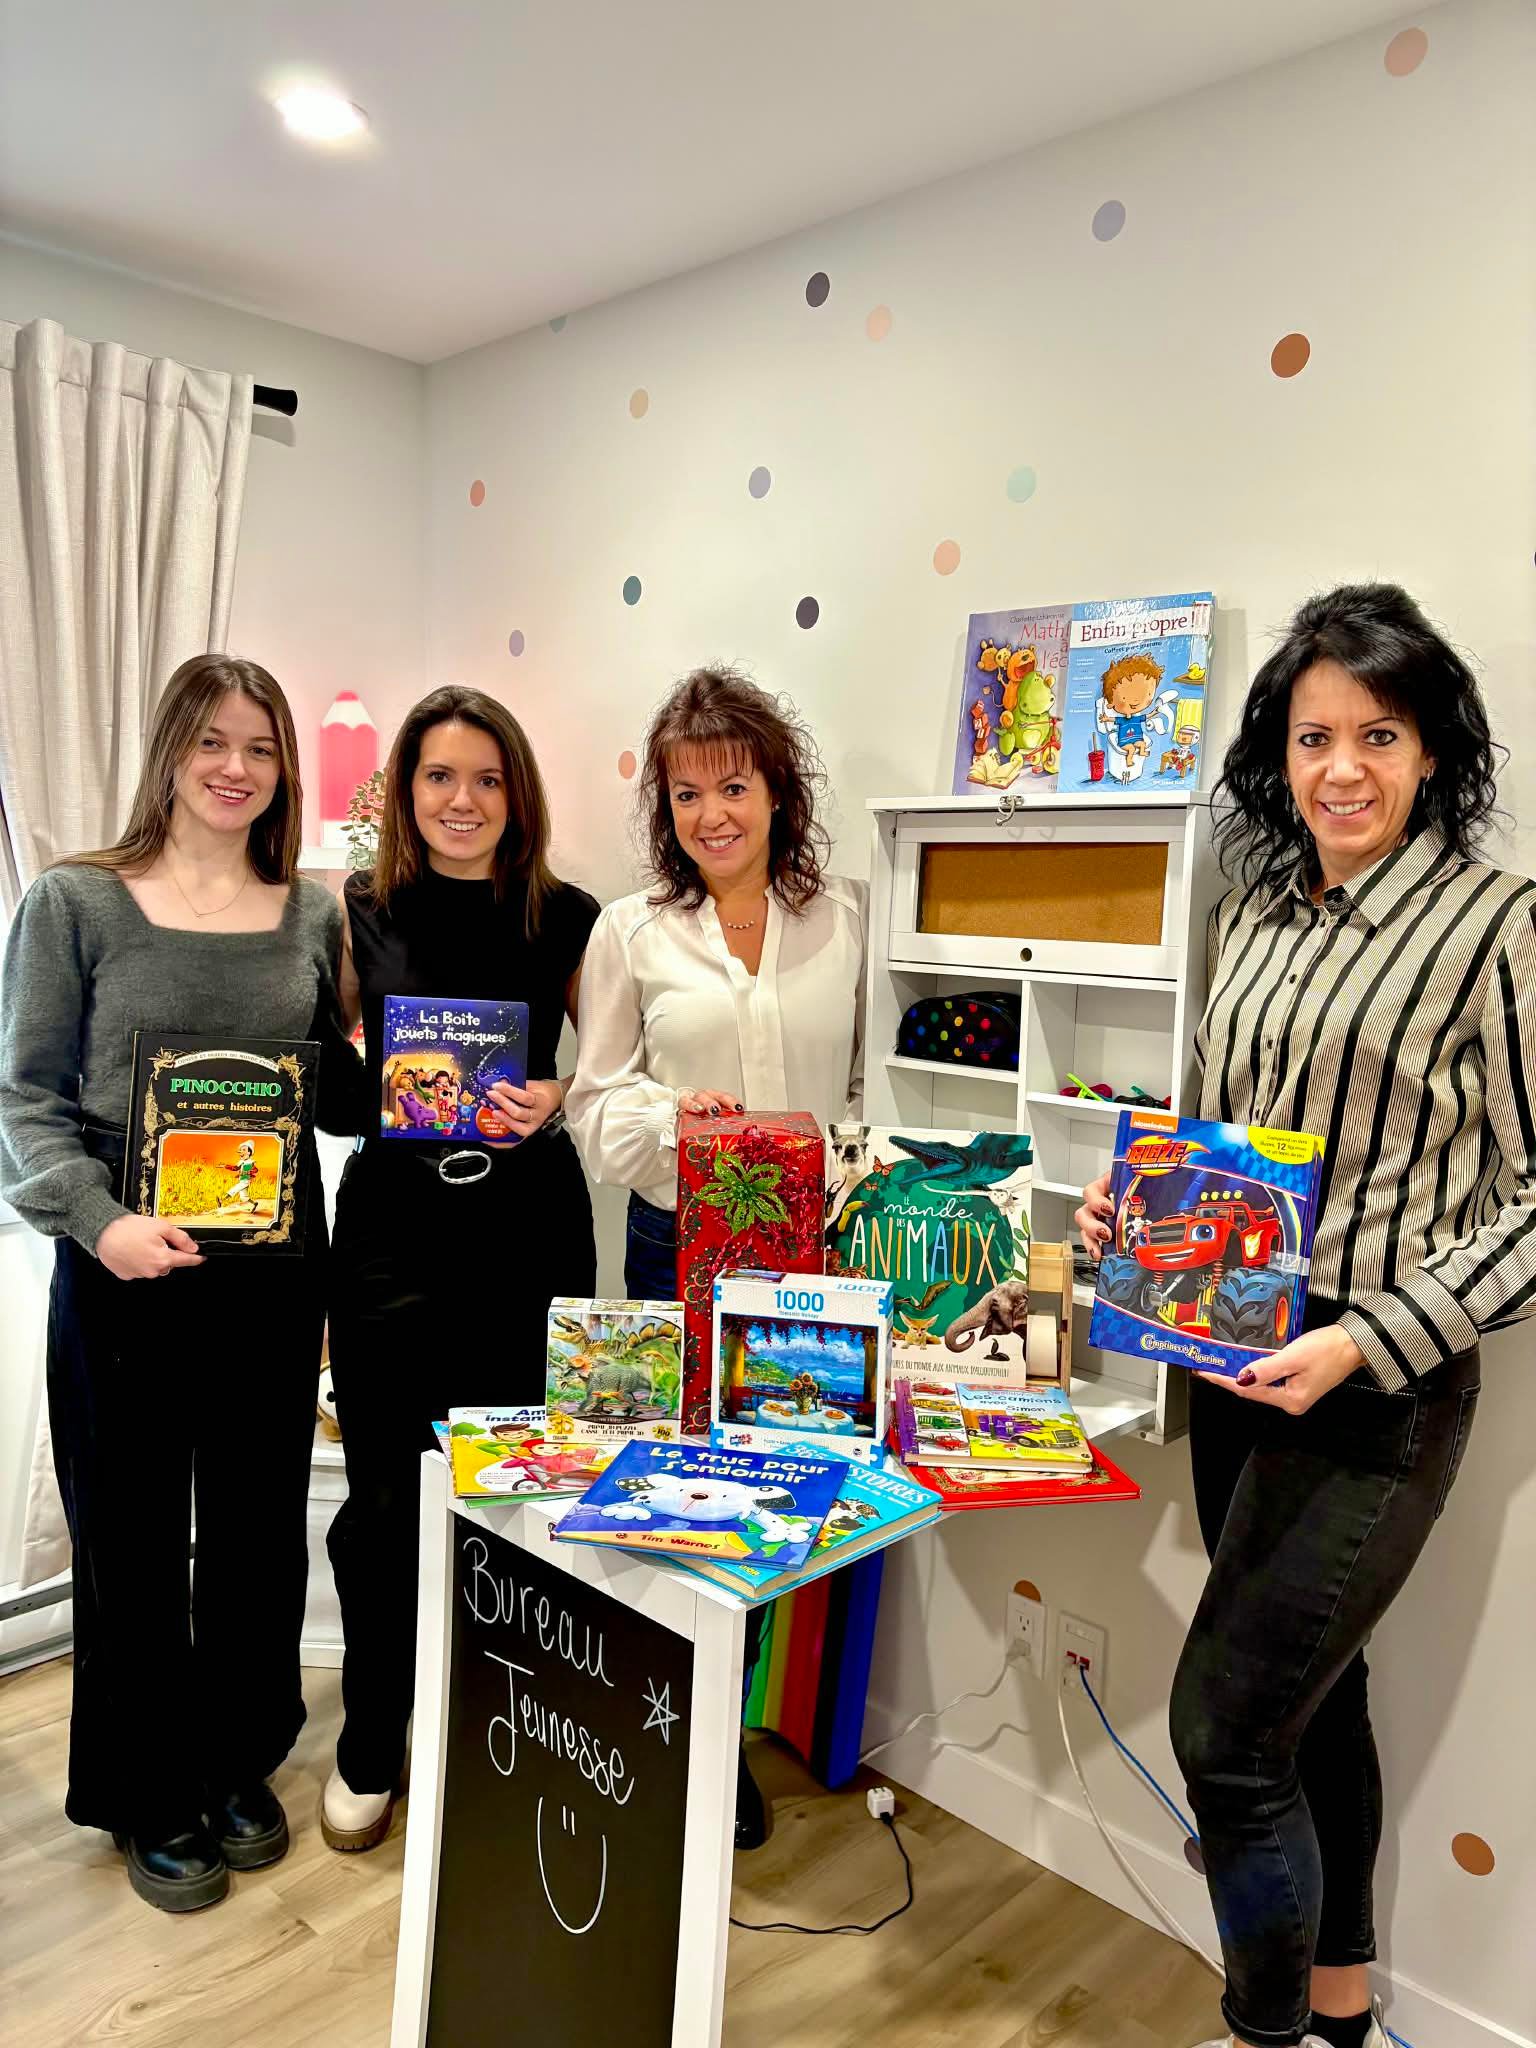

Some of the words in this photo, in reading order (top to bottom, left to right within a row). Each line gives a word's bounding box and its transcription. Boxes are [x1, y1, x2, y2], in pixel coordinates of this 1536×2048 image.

[1081, 621, 1127, 642] Enfin
[420, 1010, 439, 1024] La
[442, 1011, 481, 1026] Boîte
[393, 1026, 438, 1042] jouets
[442, 1029, 507, 1047] magiques
[170, 1078, 282, 1097] PINOCCHIO
[177, 1100, 188, 1109] et
[193, 1101, 225, 1111] autres
[229, 1102, 272, 1113] histoires
[1126, 1142, 1187, 1165] BLAZE
[1277, 1142, 1287, 1151] 12
[883, 1198, 974, 1219] monde
[903, 1196, 910, 1206] LE
[896, 1218, 906, 1228] DES
[836, 1283, 886, 1293] 1000
[774, 1289, 825, 1313] 1000
[961, 1394, 993, 1402] Les
[997, 1394, 1063, 1405] camions
[1005, 1405, 1046, 1413] Simon
[656, 1428, 671, 1437] 100
[650, 1447, 683, 1459] Le
[696, 1452, 753, 1467] truc
[762, 1461, 830, 1475] pour
[834, 1459, 932, 1504] STOIRES
[640, 1534, 664, 1543] Tim
[670, 1537, 721, 1550] Warnes
[463, 1536, 615, 1687] Bureau
[484, 1650, 635, 1805] Jeunesse
